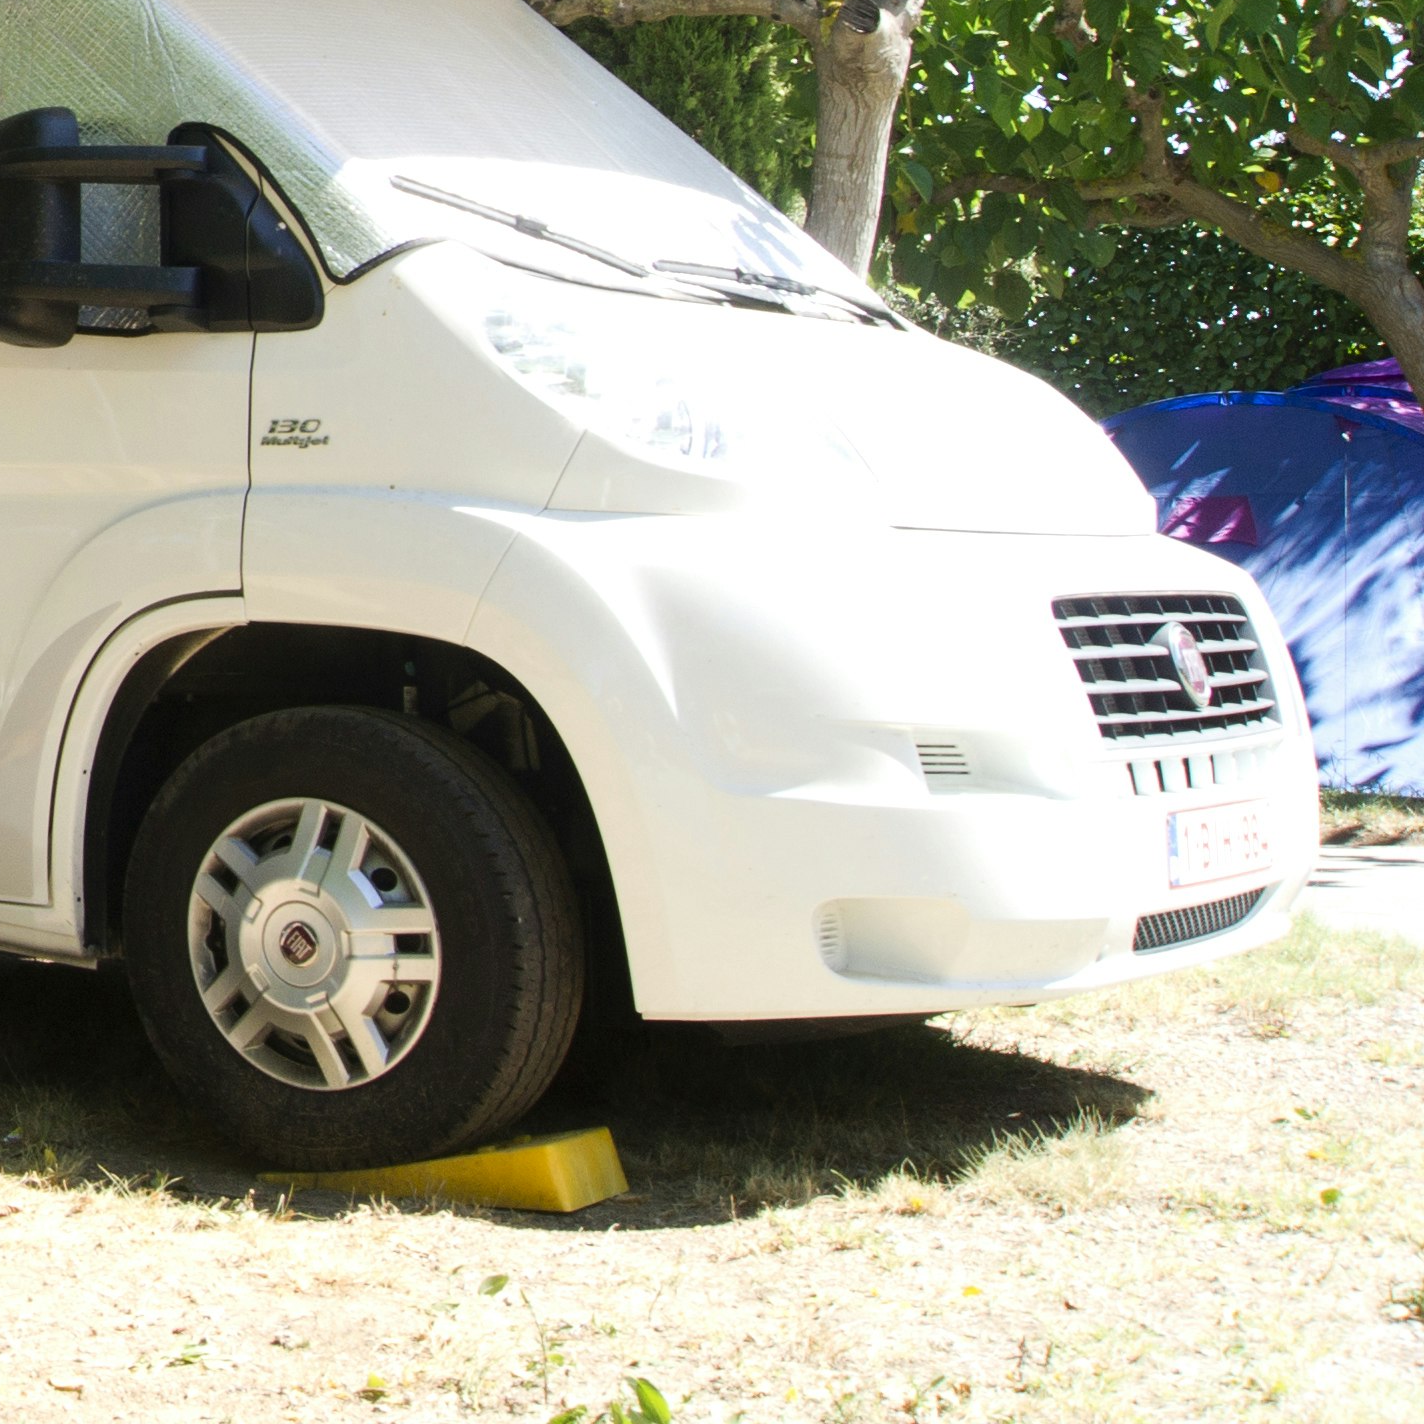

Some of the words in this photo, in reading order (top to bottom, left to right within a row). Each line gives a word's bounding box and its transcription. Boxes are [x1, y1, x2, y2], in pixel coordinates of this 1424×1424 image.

[268, 418, 322, 434] 130
[260, 435, 330, 449] Multijet
[287, 930, 313, 961] FIAT
